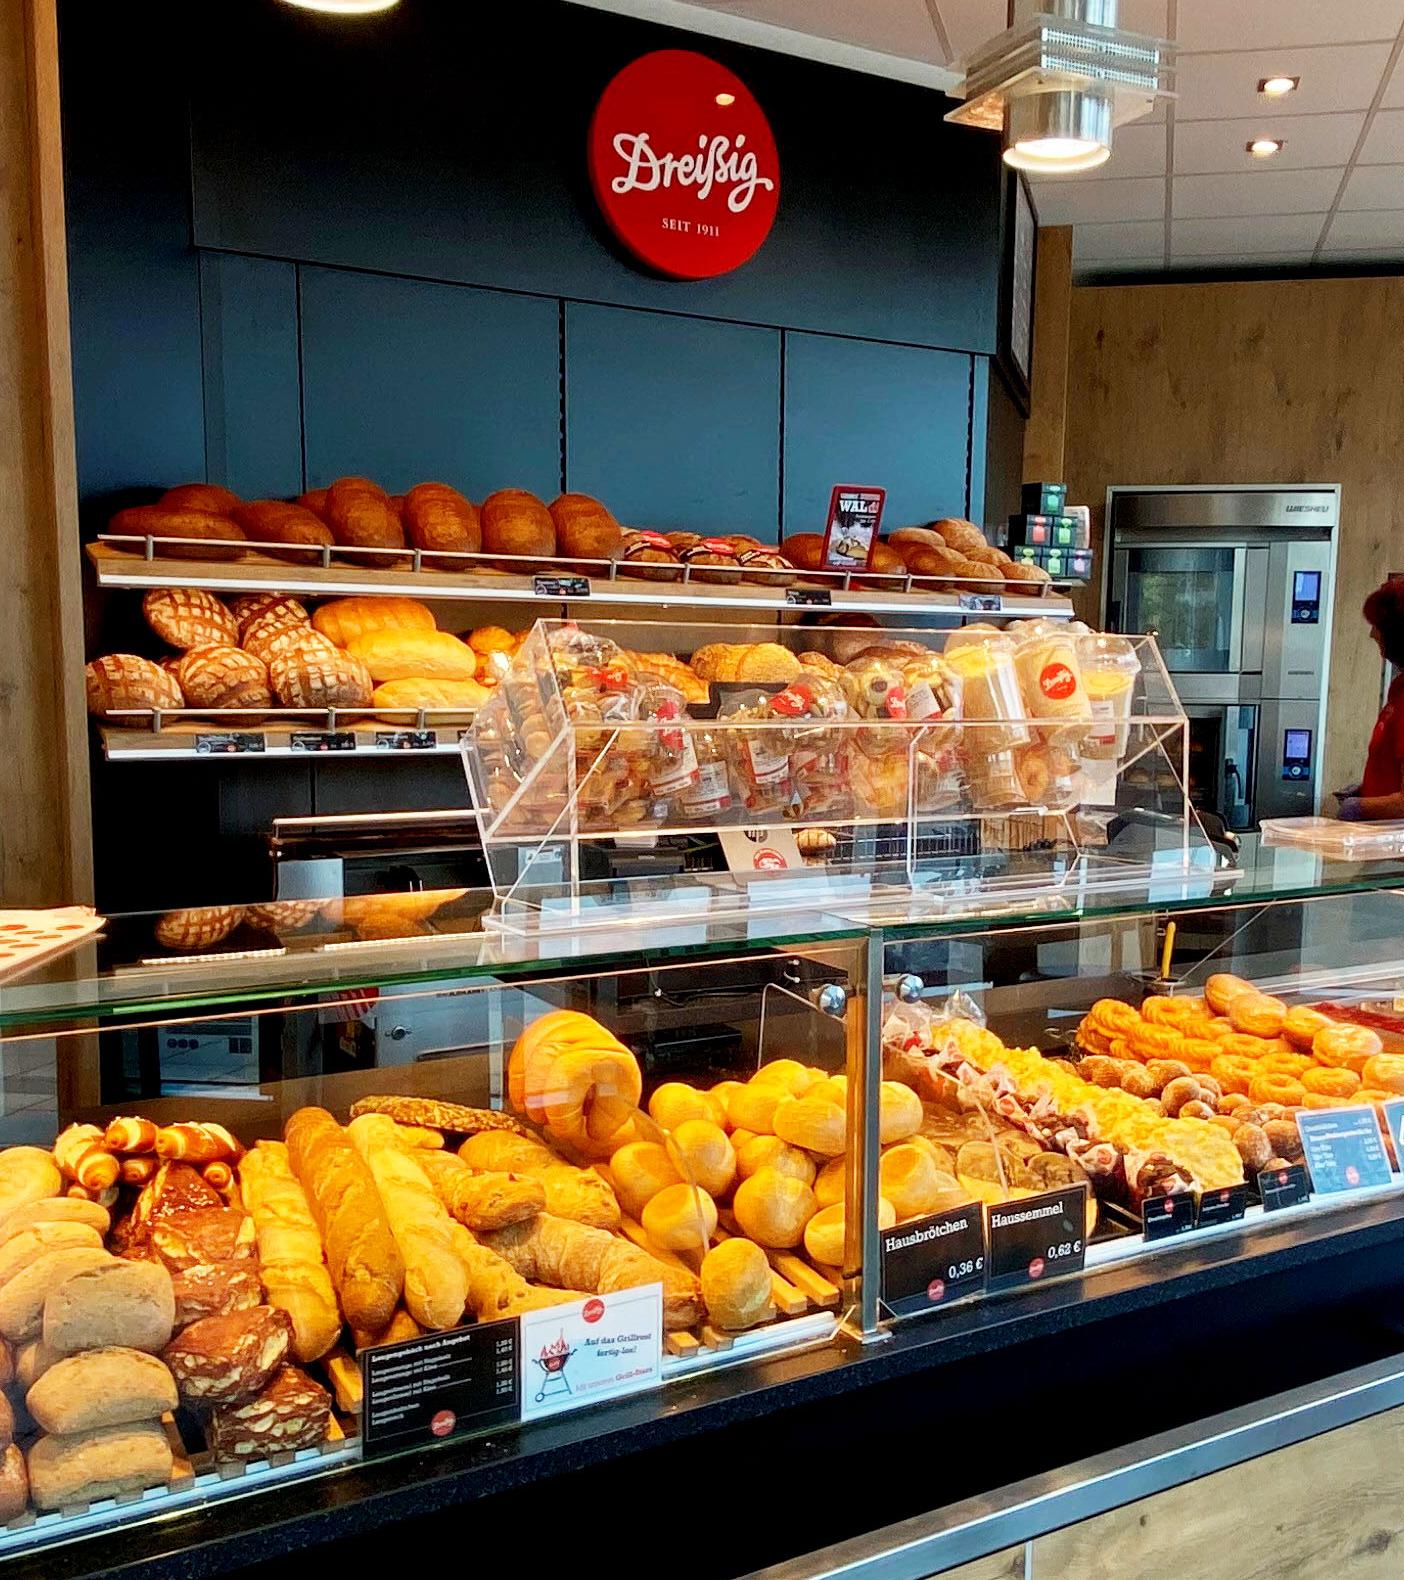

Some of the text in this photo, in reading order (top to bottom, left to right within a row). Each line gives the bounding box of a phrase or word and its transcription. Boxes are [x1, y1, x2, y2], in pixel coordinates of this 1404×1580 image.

[611, 131, 775, 214] Dreißig
[661, 217, 721, 238] SEIT 1911
[991, 1200, 1064, 1229] Haussemmel
[885, 1218, 969, 1253] Hausbrötchen
[1047, 1239, 1082, 1260] 0,62 €
[948, 1256, 984, 1279] 0,36 €
